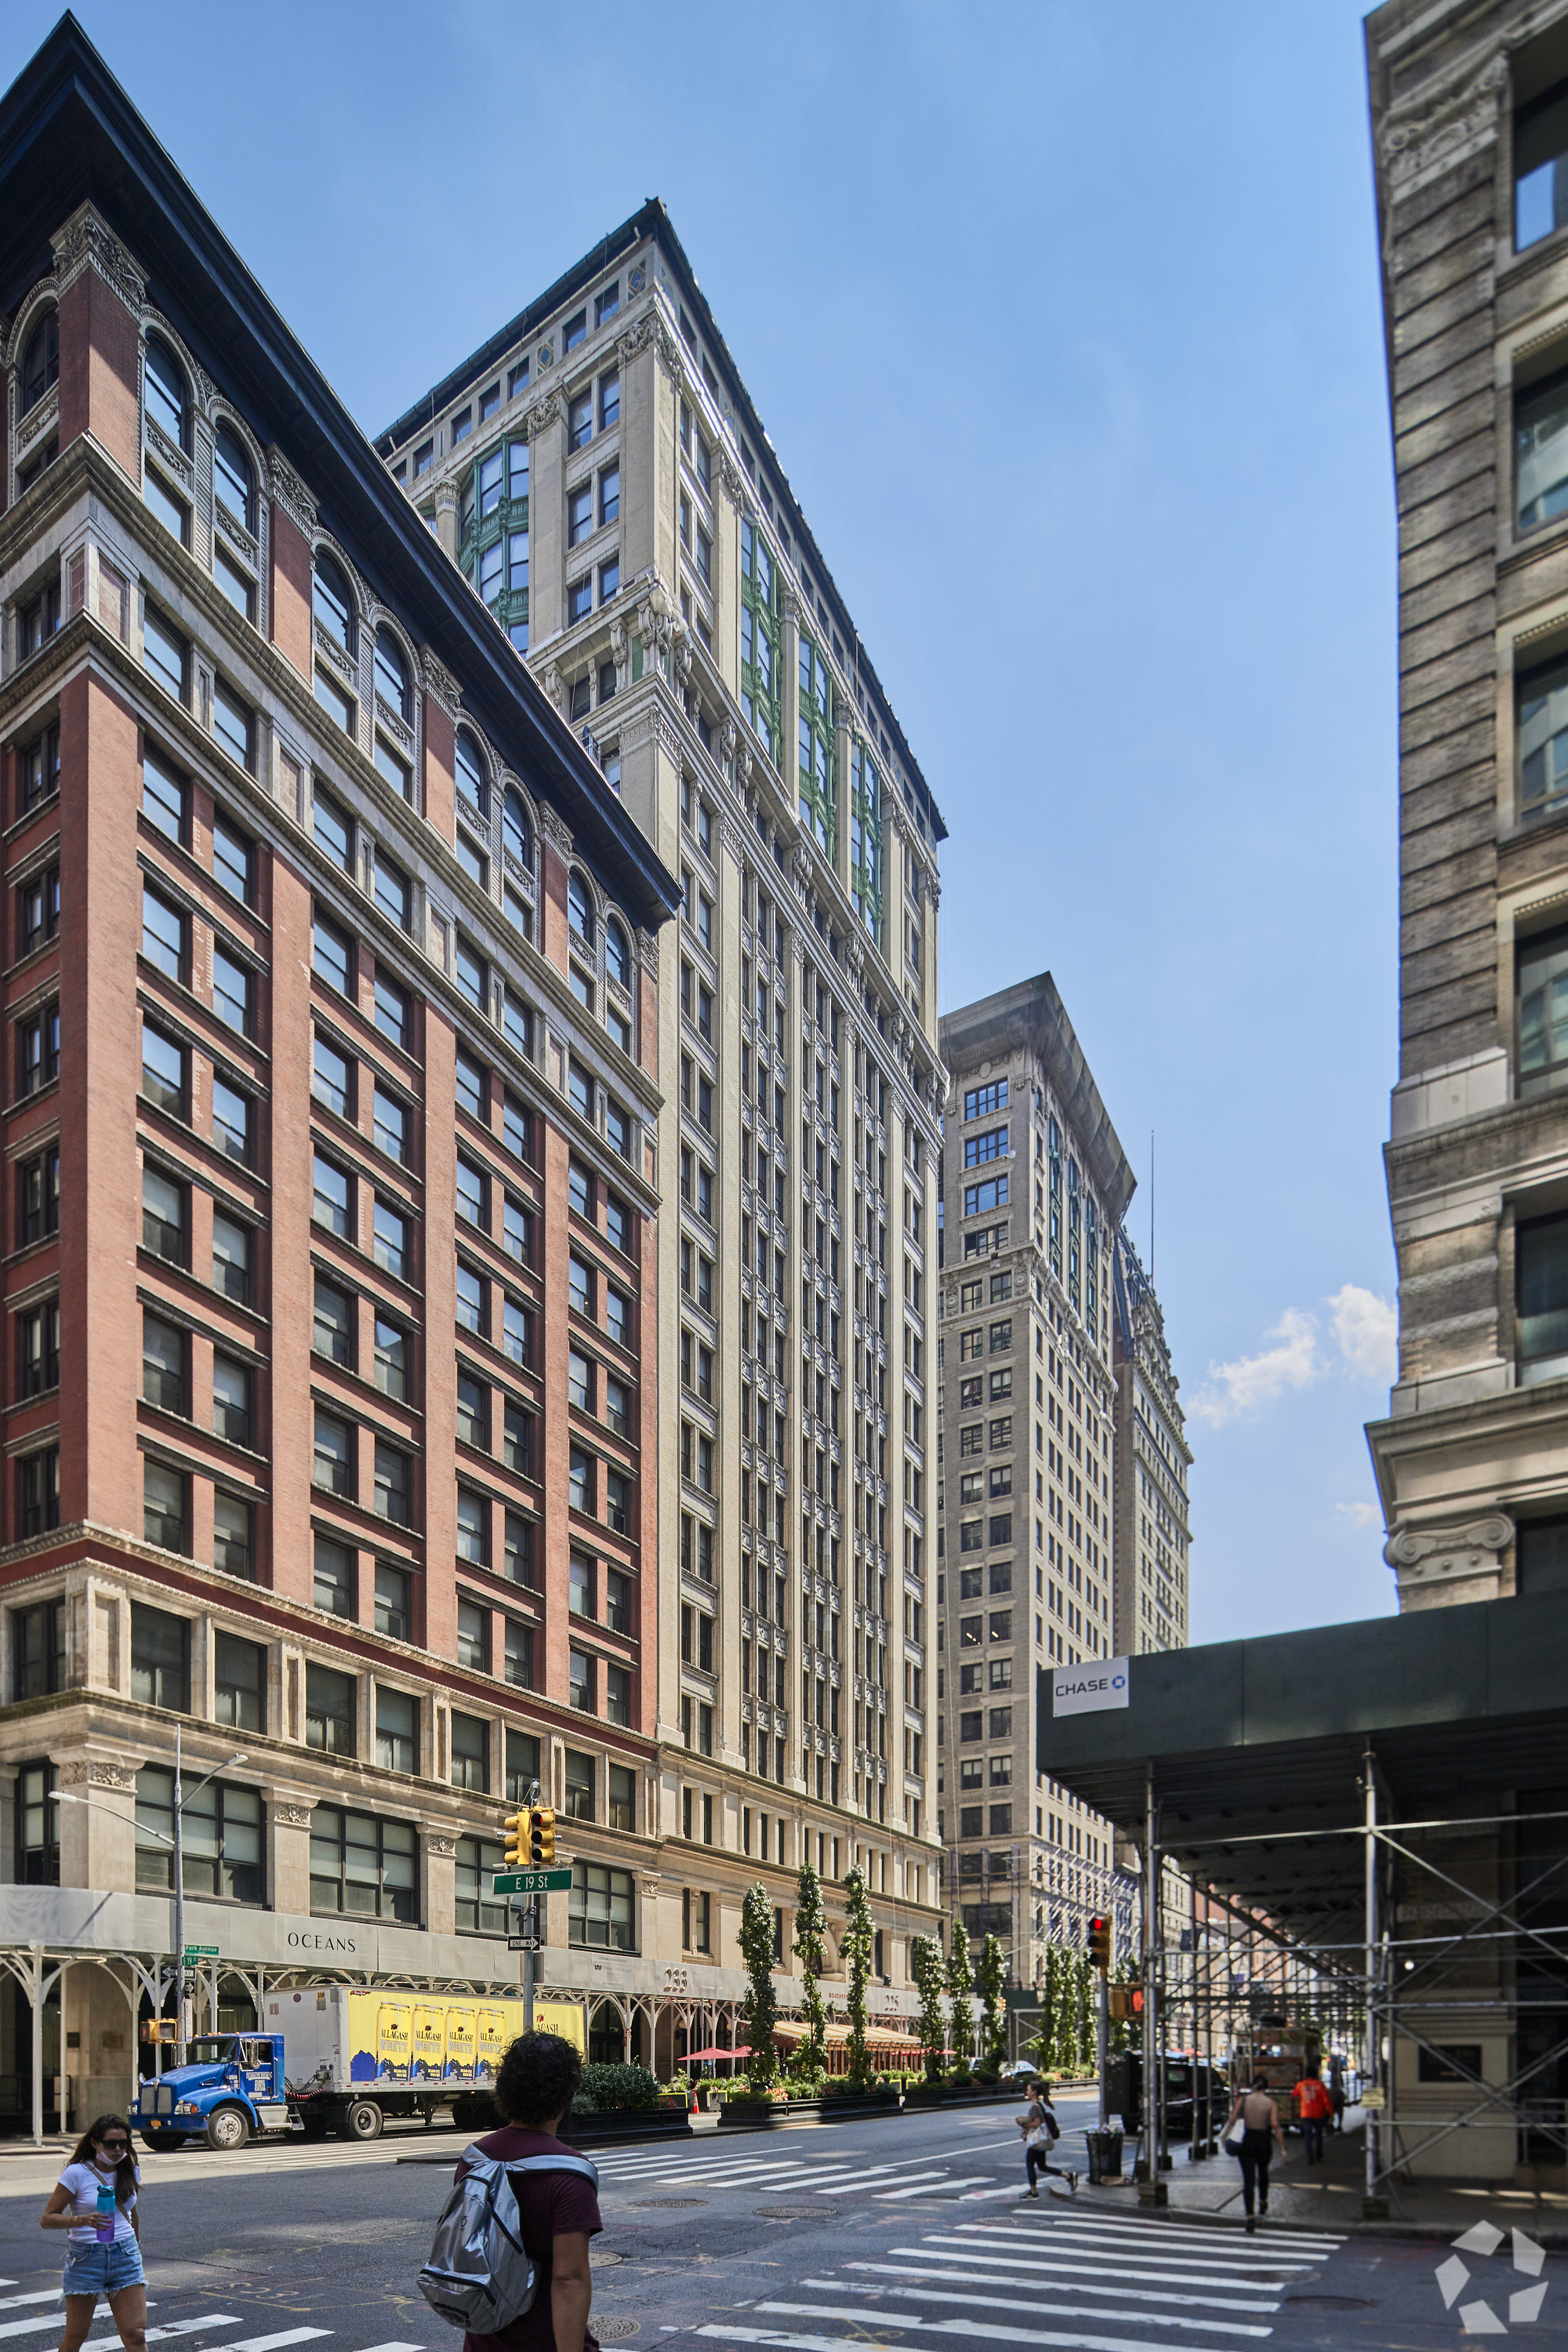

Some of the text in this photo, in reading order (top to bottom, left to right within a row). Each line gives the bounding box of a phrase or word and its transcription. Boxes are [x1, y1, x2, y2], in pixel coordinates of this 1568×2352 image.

[1055, 1678, 1109, 1697] CHASE
[515, 1875, 549, 1890] E 19 St
[288, 1932, 356, 1953] OCEANS
[663, 1967, 688, 1993] 233
[381, 2029, 408, 2041] ALLAGASH
[416, 2030, 441, 2042] ALLAGASH
[449, 2031, 474, 2042] ALLAGASH
[379, 2039, 408, 2053] WHITE
[415, 2040, 441, 2053] WHITE
[448, 2041, 473, 2054] WHITE
